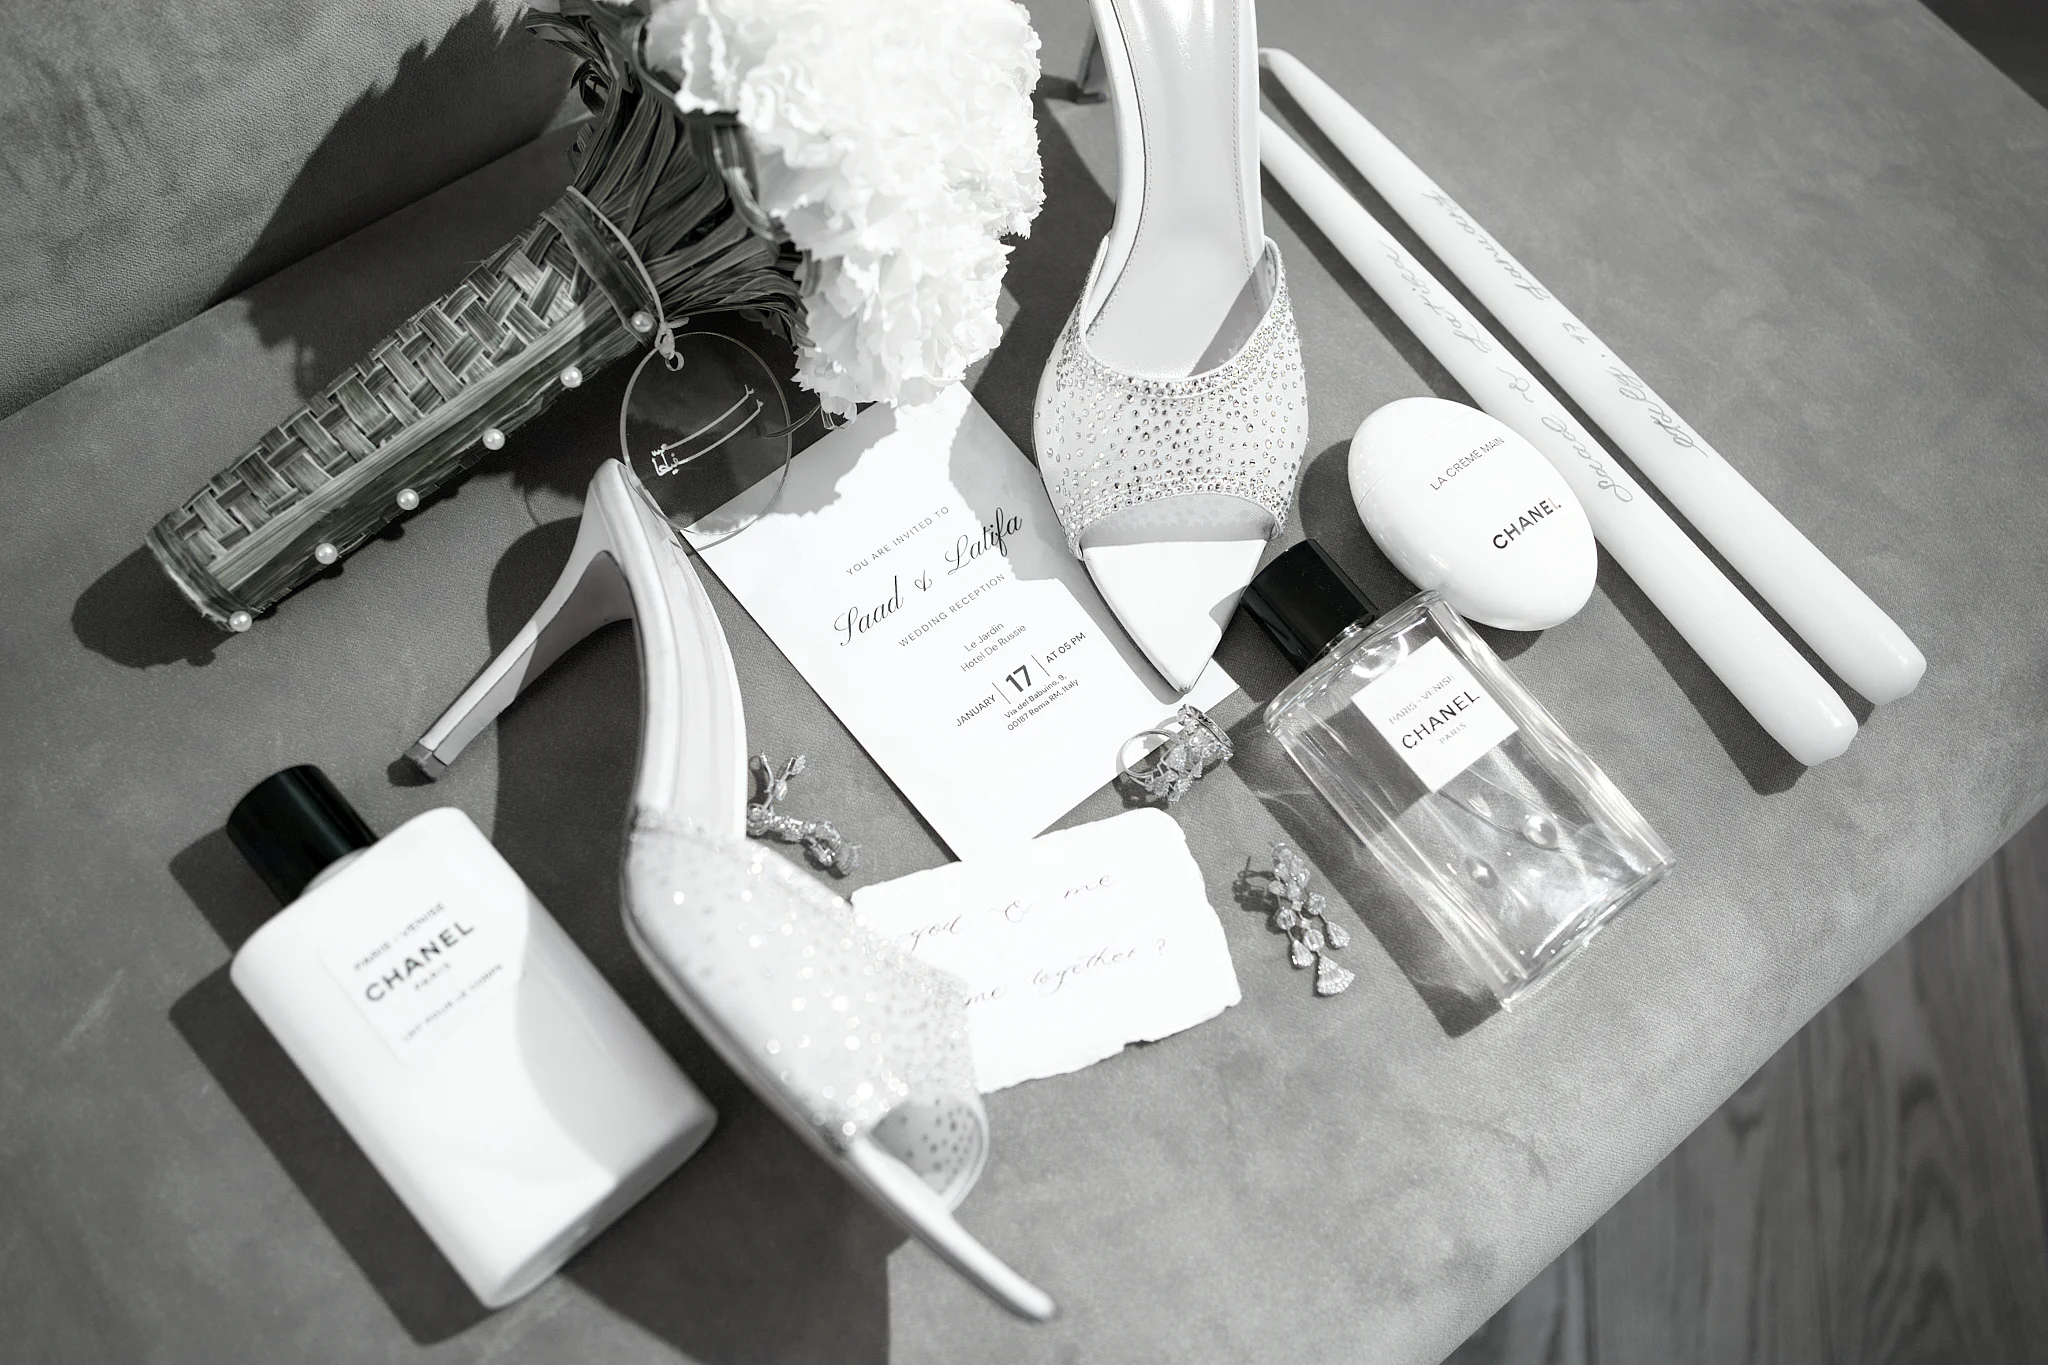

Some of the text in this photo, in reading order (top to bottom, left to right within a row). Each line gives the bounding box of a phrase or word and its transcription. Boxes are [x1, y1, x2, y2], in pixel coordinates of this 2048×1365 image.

[1421, 189, 1551, 301] January
[1562, 322, 1591, 345] 17
[1496, 366, 1535, 403] &
[1430, 476, 1448, 491] LA
[1480, 436, 1505, 454] MAIN
[1541, 413, 1634, 503] Saad
[846, 505, 950, 576] YOU ARE INVITED TO
[1492, 497, 1562, 549] CHANEL
[833, 507, 1023, 647] Saad & Latifa
[898, 573, 1006, 648] WEDDING RECEPTION
[960, 624, 1027, 673] Hotel De Russie
[964, 622, 1005, 652] Le Jardin
[956, 632, 1087, 727] JANUARY 17 AT 05 PM
[1003, 709, 1018, 719] Via
[1017, 698, 1030, 711] del
[1027, 680, 1060, 703] Babuino,
[1007, 679, 1079, 731] 00187 Roma RM, Italy
[1388, 701, 1418, 725] PARIS
[1421, 673, 1457, 701] VENISE
[1402, 691, 1481, 749] CHANEL
[1438, 722, 1468, 745] PARIS
[1063, 874, 1112, 898] me
[365, 921, 476, 1002] CHANEL
[1033, 946, 1138, 997] together
